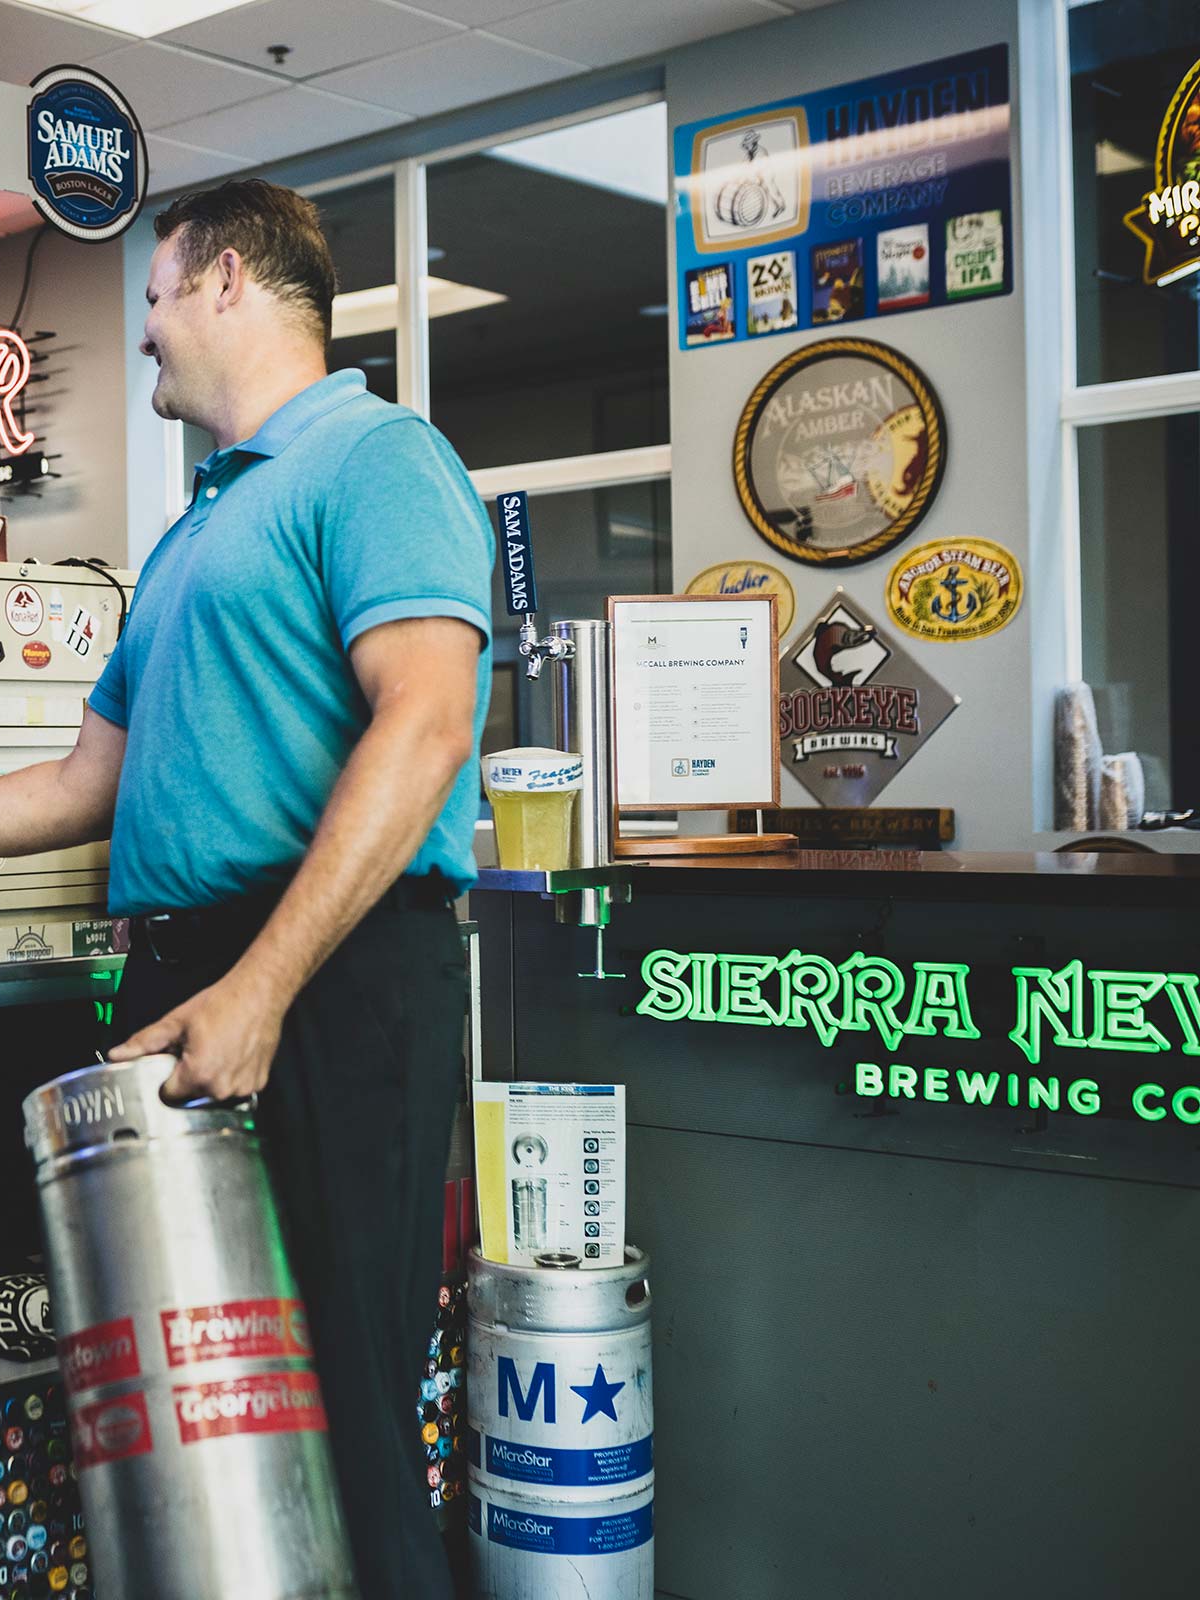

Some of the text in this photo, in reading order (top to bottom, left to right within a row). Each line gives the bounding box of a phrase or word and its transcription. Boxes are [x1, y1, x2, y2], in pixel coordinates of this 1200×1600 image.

[37, 110, 130, 159] SAMUEL
[826, 71, 988, 166] HAYDEN
[44, 141, 123, 183] ADAMS
[827, 154, 947, 199] BEVERAGE
[56, 180, 113, 201] BOSTON LAGER
[827, 182, 948, 226] COMPANY
[955, 249, 996, 268] CYCLOPS
[962, 267, 991, 283] IPA
[761, 372, 895, 437] ALASKAN
[795, 411, 865, 443] AMBER
[503, 496, 528, 610] SAM ADAMS
[899, 550, 1010, 592] ANCHOR STEAM BEER
[75, 608, 83, 625] I
[66, 629, 90, 656] ID
[706, 659, 745, 667] COMPANY
[780, 686, 918, 737] SOCKEYE
[810, 735, 879, 749] BREWING
[692, 759, 715, 769] HAYDEN
[636, 948, 981, 1052] SIERRA
[855, 1063, 1200, 1124] BREWING CO
[168, 1310, 285, 1347] Brewing
[498, 1355, 557, 1424] M
[492, 1443, 552, 1468] MicroStar
[593, 1448, 625, 1458] PROPERTY
[493, 1510, 553, 1536] MicroStar
[596, 1526, 621, 1535] QUALITY
